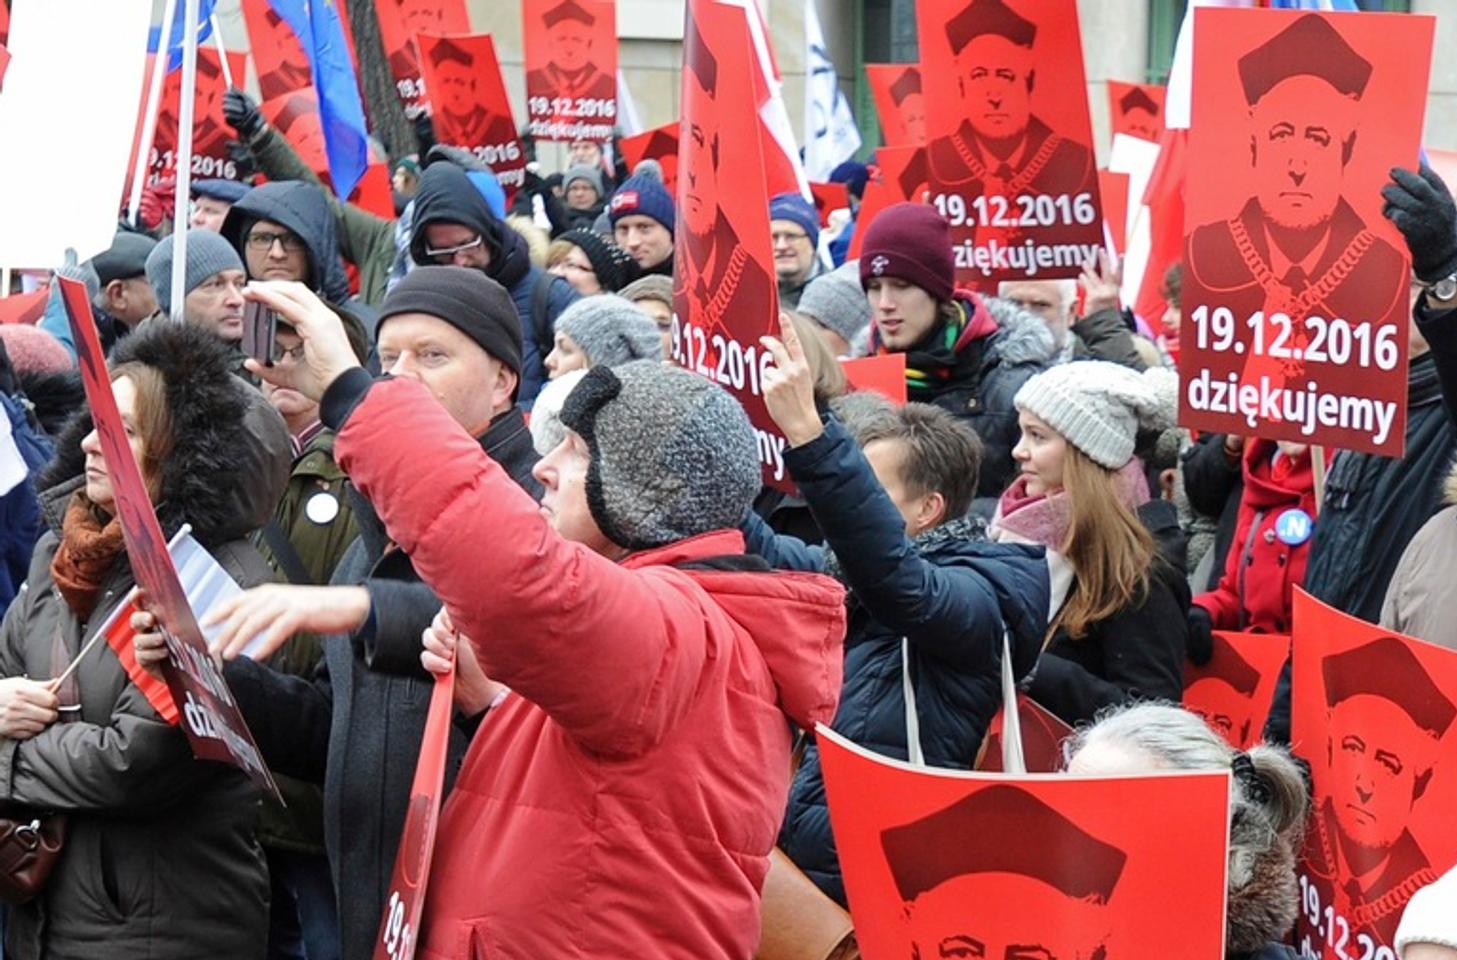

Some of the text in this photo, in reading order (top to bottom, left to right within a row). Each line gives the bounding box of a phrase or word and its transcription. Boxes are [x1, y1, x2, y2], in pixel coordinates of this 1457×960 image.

[934, 193, 1096, 227] 19.12.2016
[952, 238, 1099, 276] ziękujemy
[1191, 305, 1399, 371] 19.12.2016
[1188, 368, 1397, 445] dziękujemy
